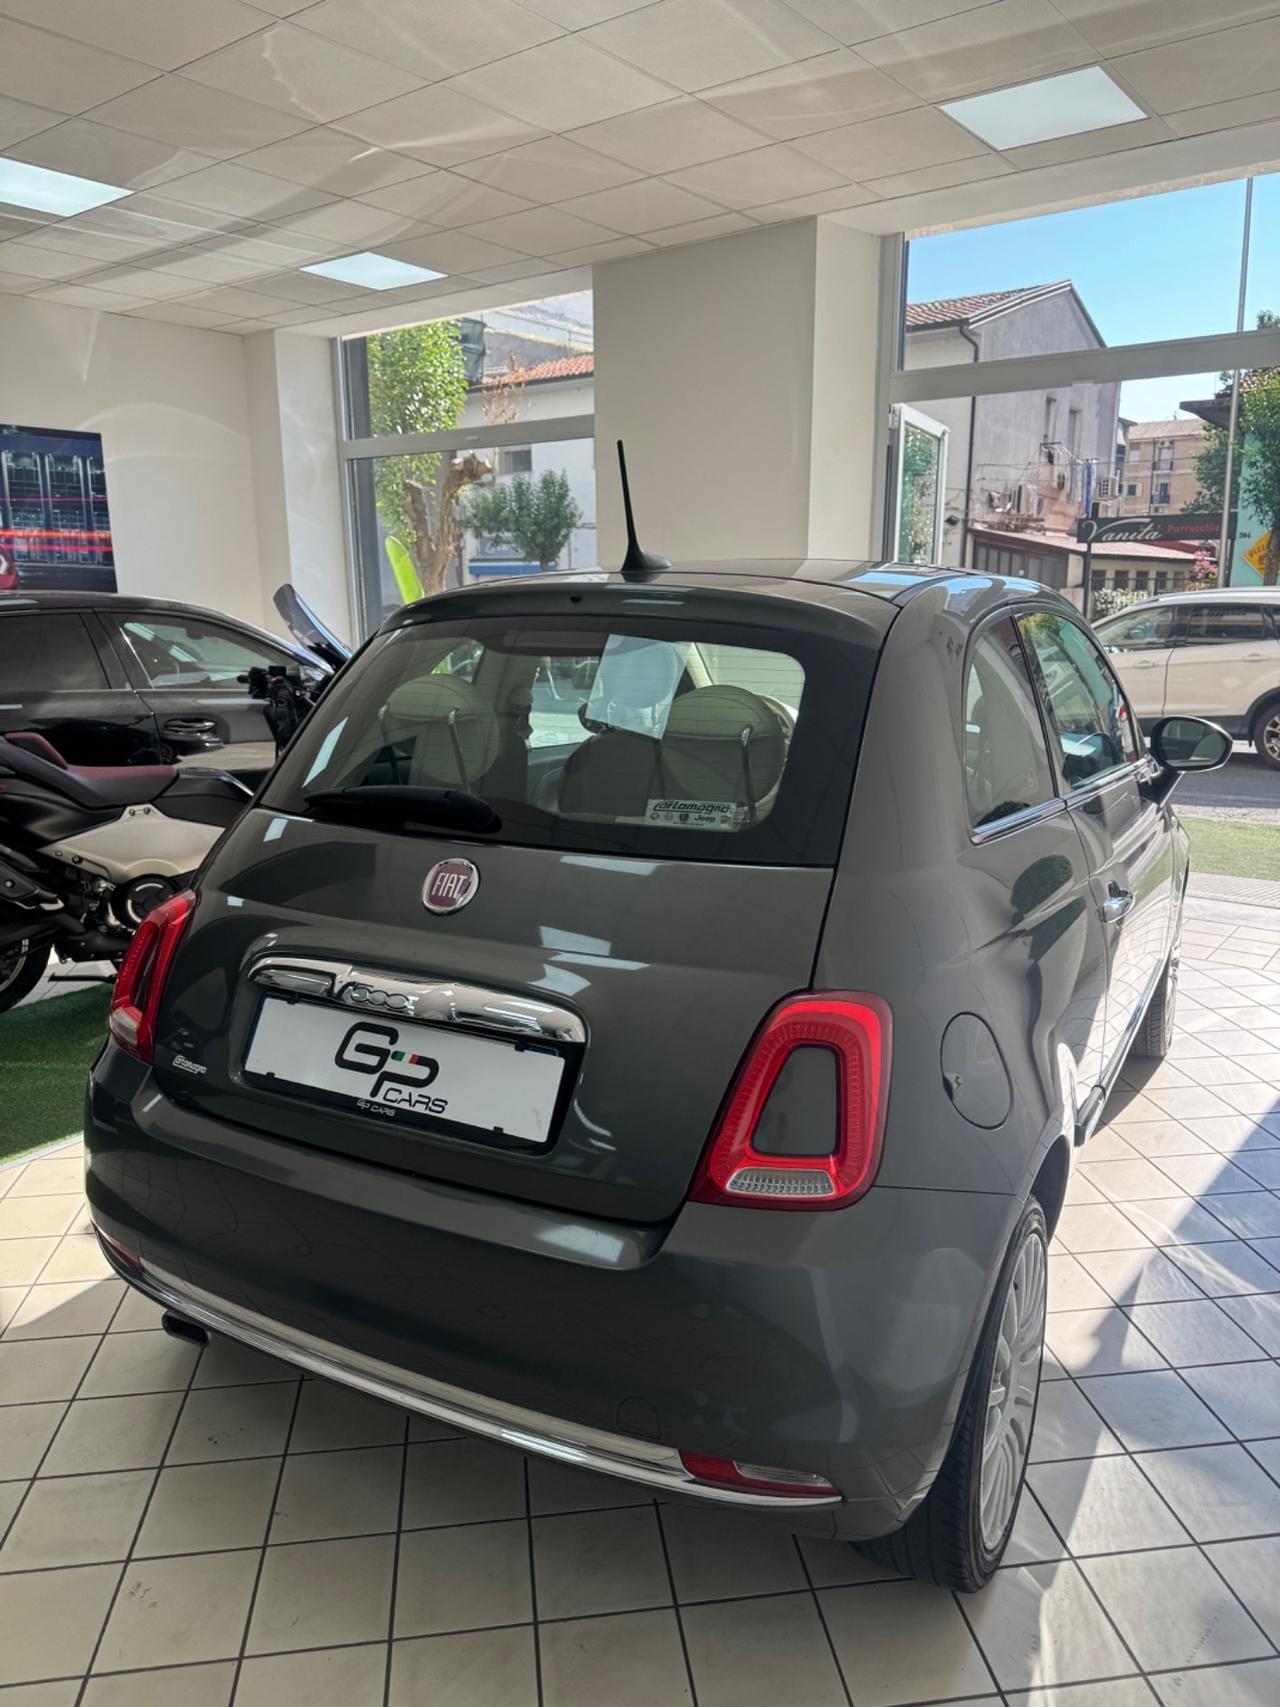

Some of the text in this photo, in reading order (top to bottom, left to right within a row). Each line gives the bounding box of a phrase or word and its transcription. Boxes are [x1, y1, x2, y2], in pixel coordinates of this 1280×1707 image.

[694, 814, 716, 823] Jeep
[432, 872, 467, 898] FIAT
[350, 981, 410, 1009] 500
[334, 1021, 440, 1098] GP
[382, 1087, 449, 1114] CARS
